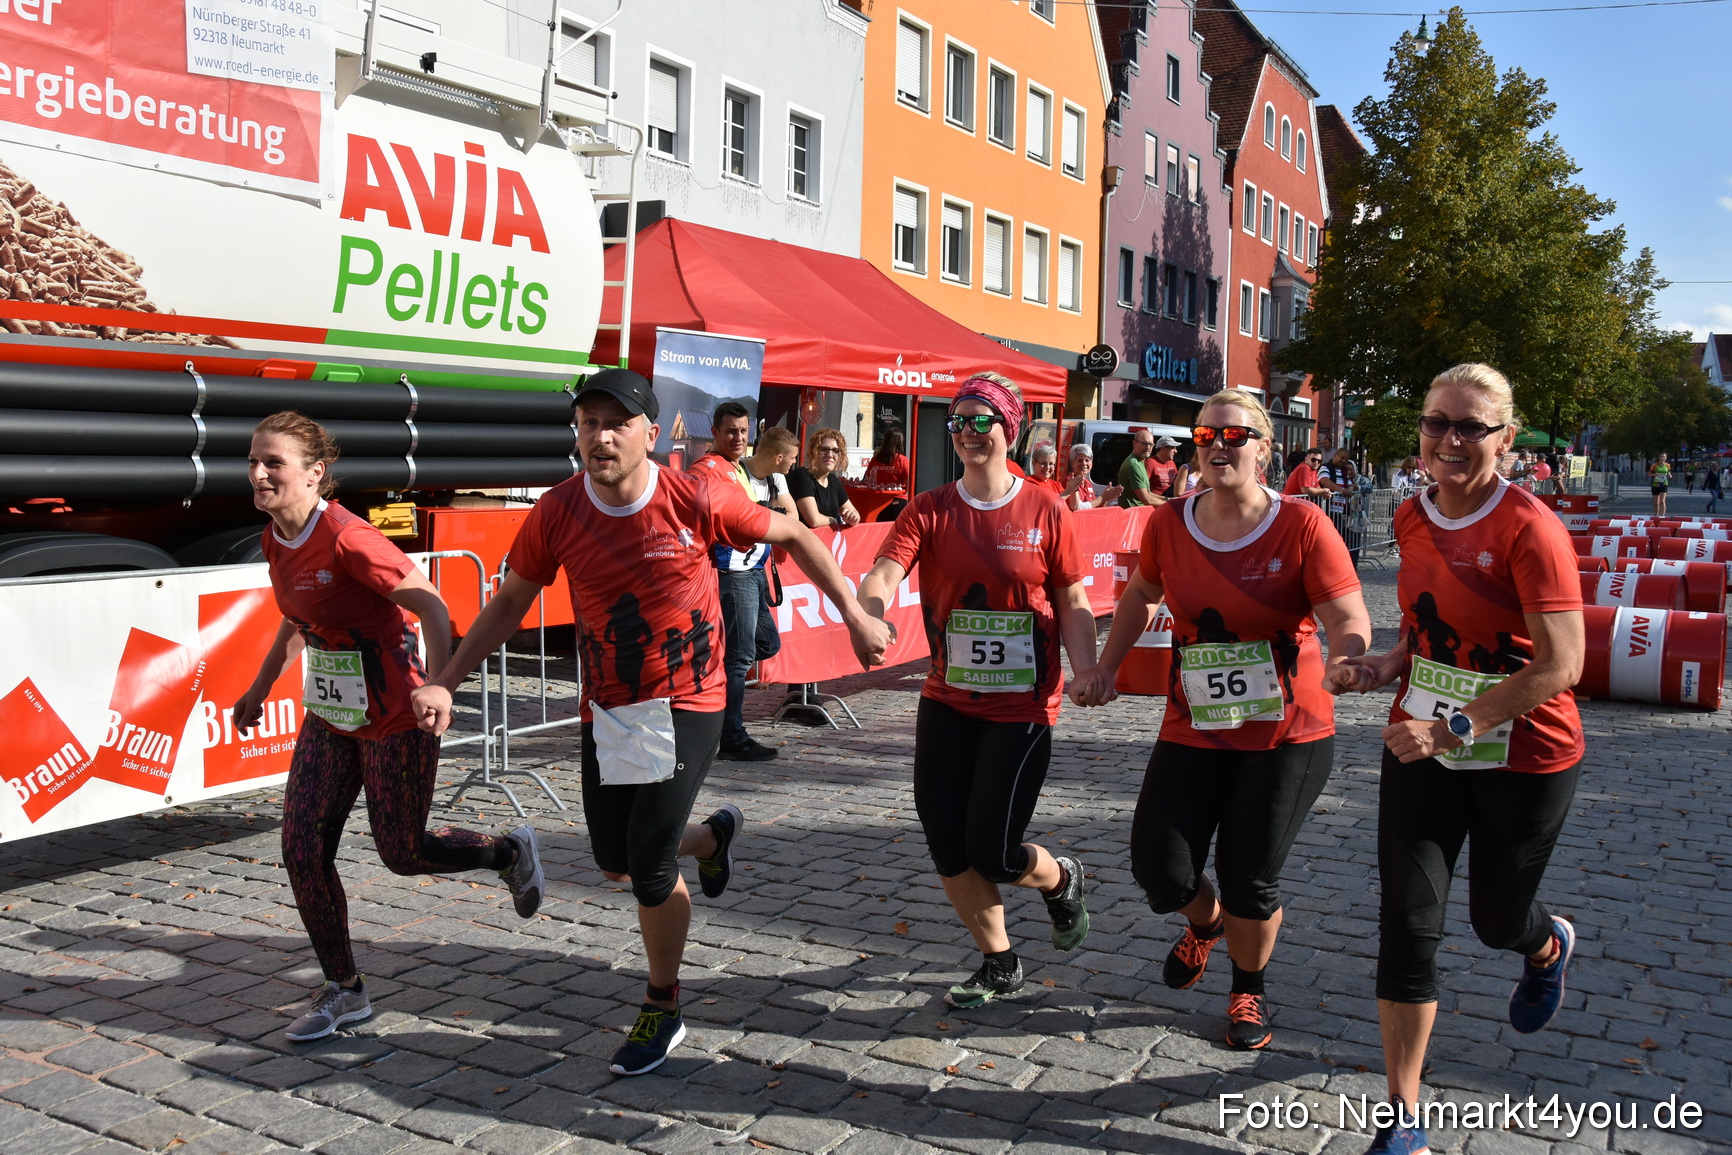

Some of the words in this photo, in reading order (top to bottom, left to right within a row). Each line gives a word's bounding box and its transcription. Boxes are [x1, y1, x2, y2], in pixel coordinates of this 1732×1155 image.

[193, 7, 258, 32] Nürnberger
[260, 20, 296, 38] Straße
[298, 27, 311, 40] 41
[193, 27, 228, 45] 92318
[231, 33, 285, 56] Neumarkt
[194, 56, 319, 84] www.roedl-energie.de
[332, 234, 549, 335] Pellets
[660, 349, 695, 365] Strom
[698, 356, 720, 367] von
[722, 356, 752, 371] AVIA.
[644, 550, 675, 558] nürnberg
[997, 545, 1024, 553] nürnberg
[952, 613, 1027, 634] BOCK
[308, 652, 357, 674] OCK
[971, 640, 1005, 665] 53
[1186, 643, 1264, 668] BOCK
[196, 660, 207, 678] 1929
[963, 671, 1014, 684] SABINE
[314, 676, 342, 703] 54
[1207, 669, 1248, 699] 56
[1206, 703, 1260, 720] NICOLE
[99, 708, 173, 764] Braun
[240, 742, 268, 759] Sicher
[270, 744, 281, 754] ist
[6, 742, 83, 806] Braun
[121, 757, 140, 772] Sicher
[139, 761, 149, 773] ist
[149, 765, 172, 780] sicher
[47, 777, 67, 795] Sicher
[67, 771, 76, 781] ist
